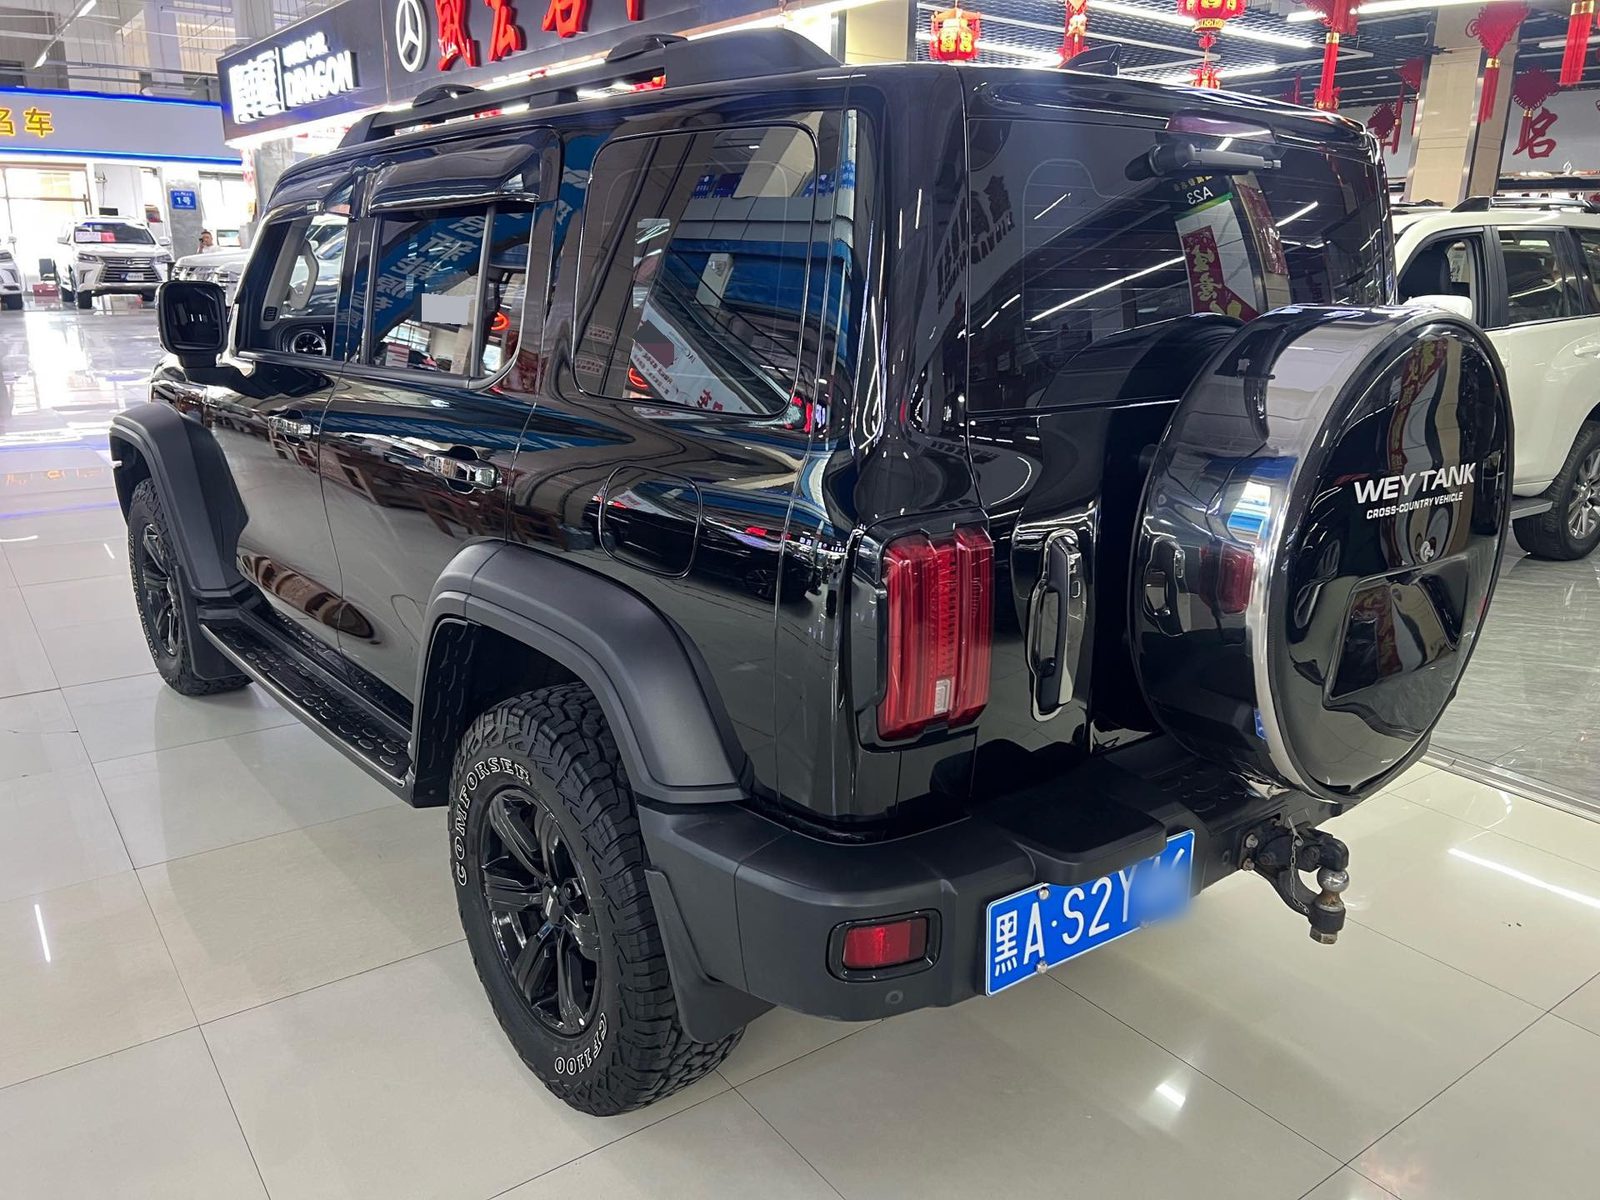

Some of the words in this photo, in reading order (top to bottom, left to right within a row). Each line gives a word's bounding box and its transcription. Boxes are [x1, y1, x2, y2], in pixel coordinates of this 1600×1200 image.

[284, 50, 354, 107] DRAGON
[1354, 473, 1416, 504] WEY
[1420, 462, 1476, 492] TANK
[1366, 497, 1434, 520] CROSS-COUNTRY
[1434, 491, 1464, 506] VEHICLE
[455, 757, 532, 886] COMFORSER
[555, 1012, 608, 1076] CF1100
